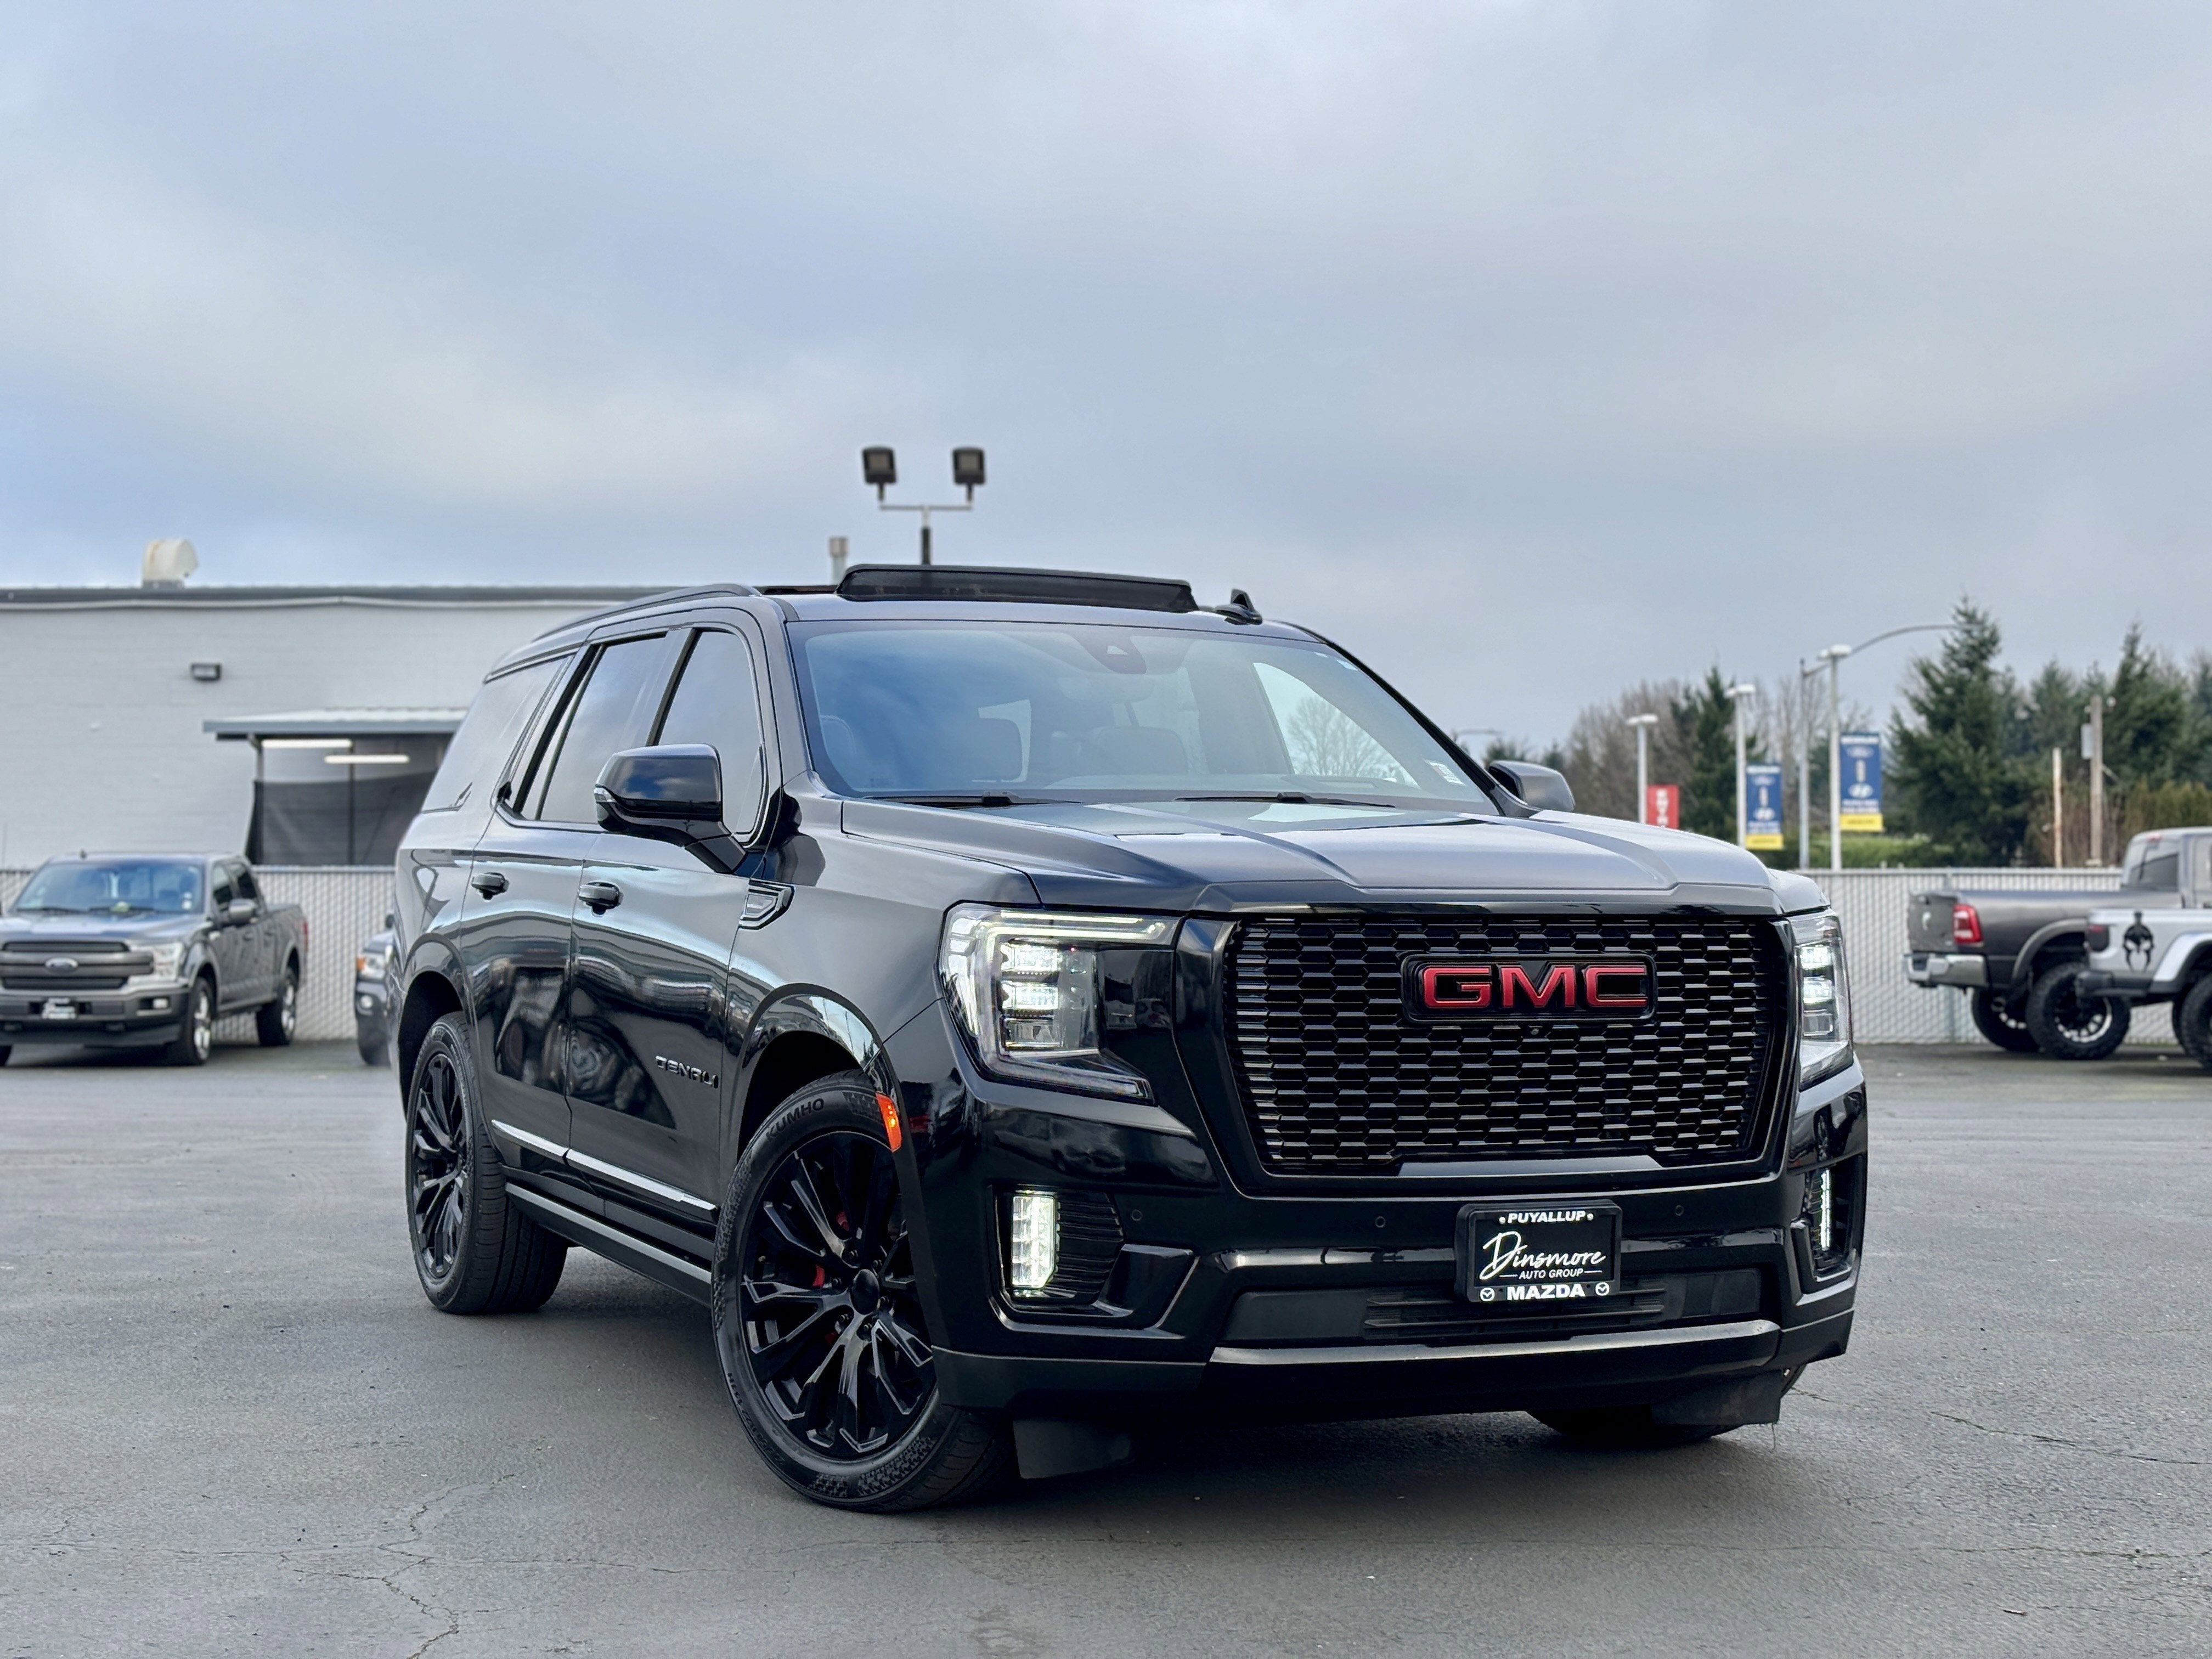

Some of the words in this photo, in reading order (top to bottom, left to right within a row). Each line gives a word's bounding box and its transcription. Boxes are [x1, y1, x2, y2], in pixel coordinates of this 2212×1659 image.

[1423, 964, 1648, 1008] GMC
[654, 1055, 719, 1089] DENALI
[765, 1098, 825, 1142] KUMHO
[1507, 1210, 1587, 1224] PUYALLUP
[1479, 1231, 1606, 1280] Dinsmore
[1518, 1269, 1546, 1280] AUTO
[1548, 1268, 1584, 1278] GROUP
[1506, 1283, 1585, 1301] MAZDA
